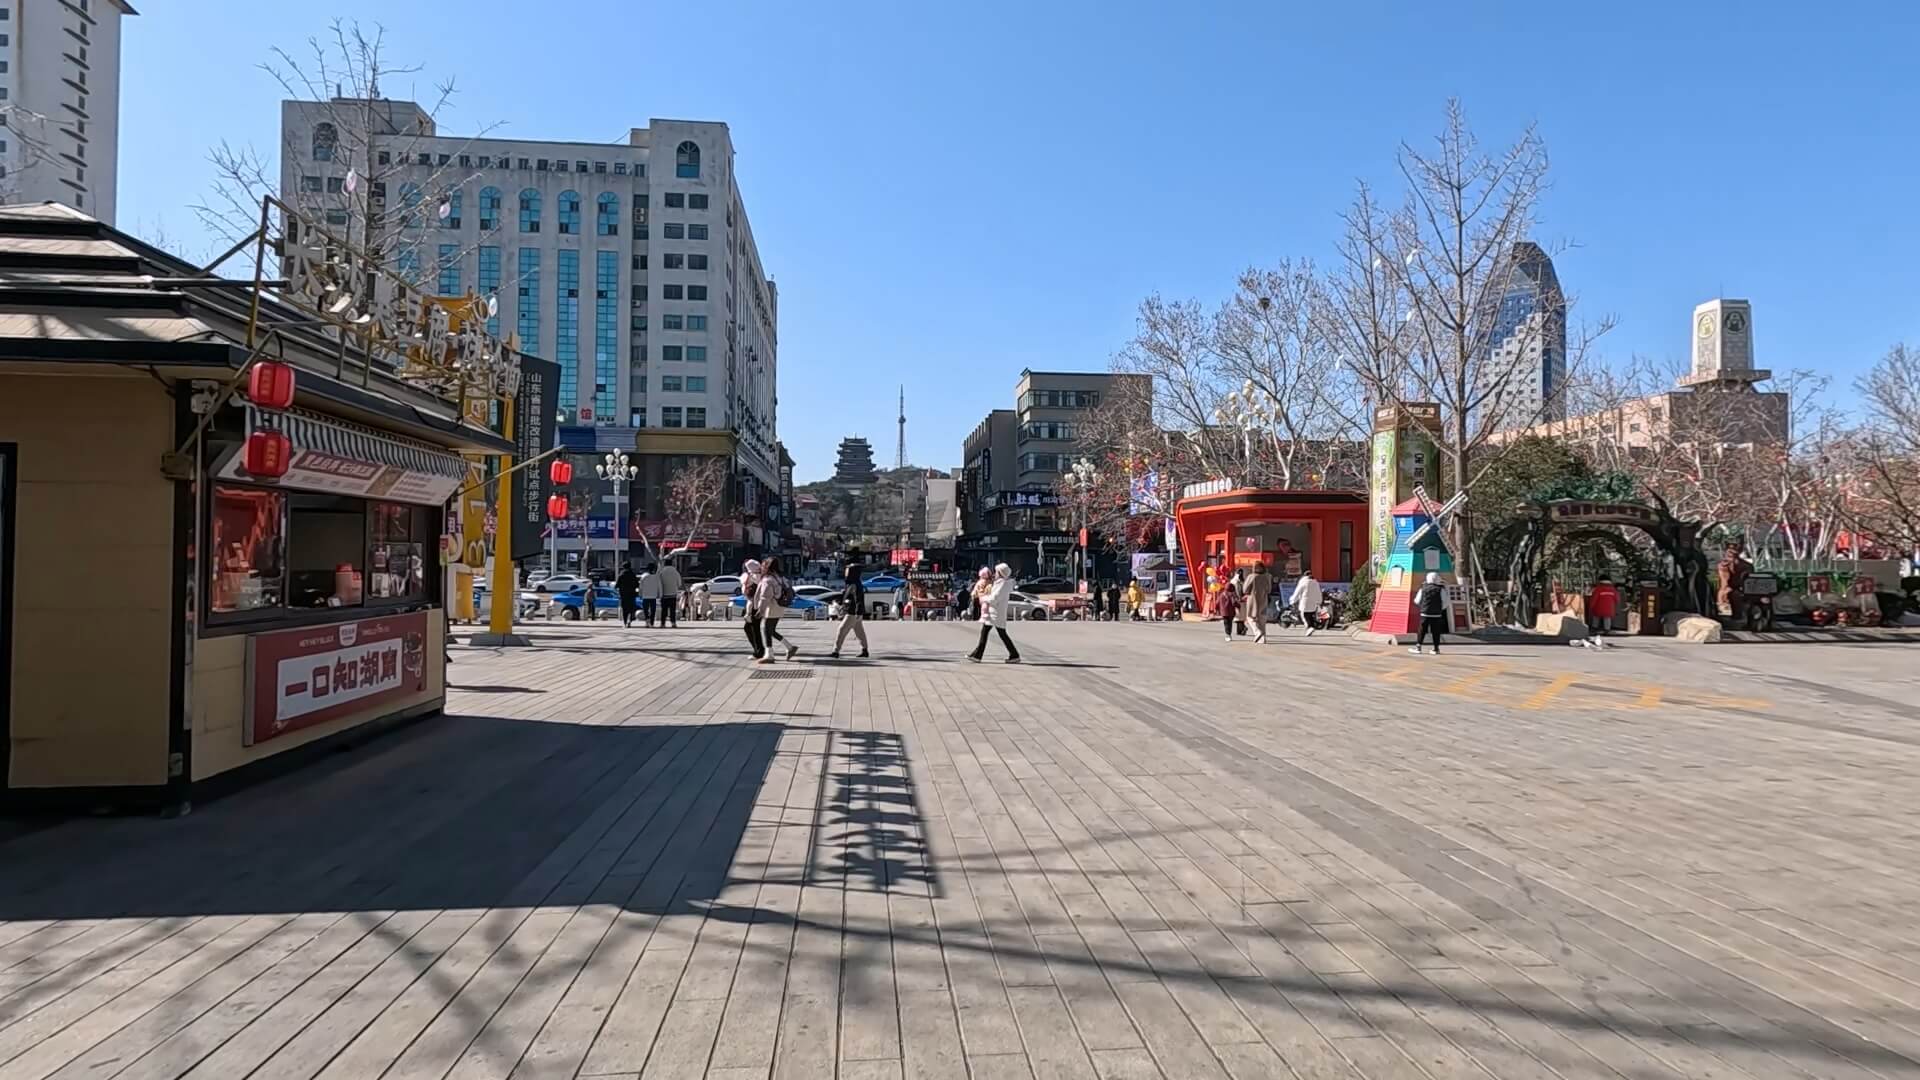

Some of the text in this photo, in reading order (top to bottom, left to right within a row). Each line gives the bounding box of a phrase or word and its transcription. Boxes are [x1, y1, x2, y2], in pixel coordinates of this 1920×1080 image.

[528, 372, 542, 522] 山东省首批改造提升试点步行街
[285, 646, 398, 698] 一口知湖南
